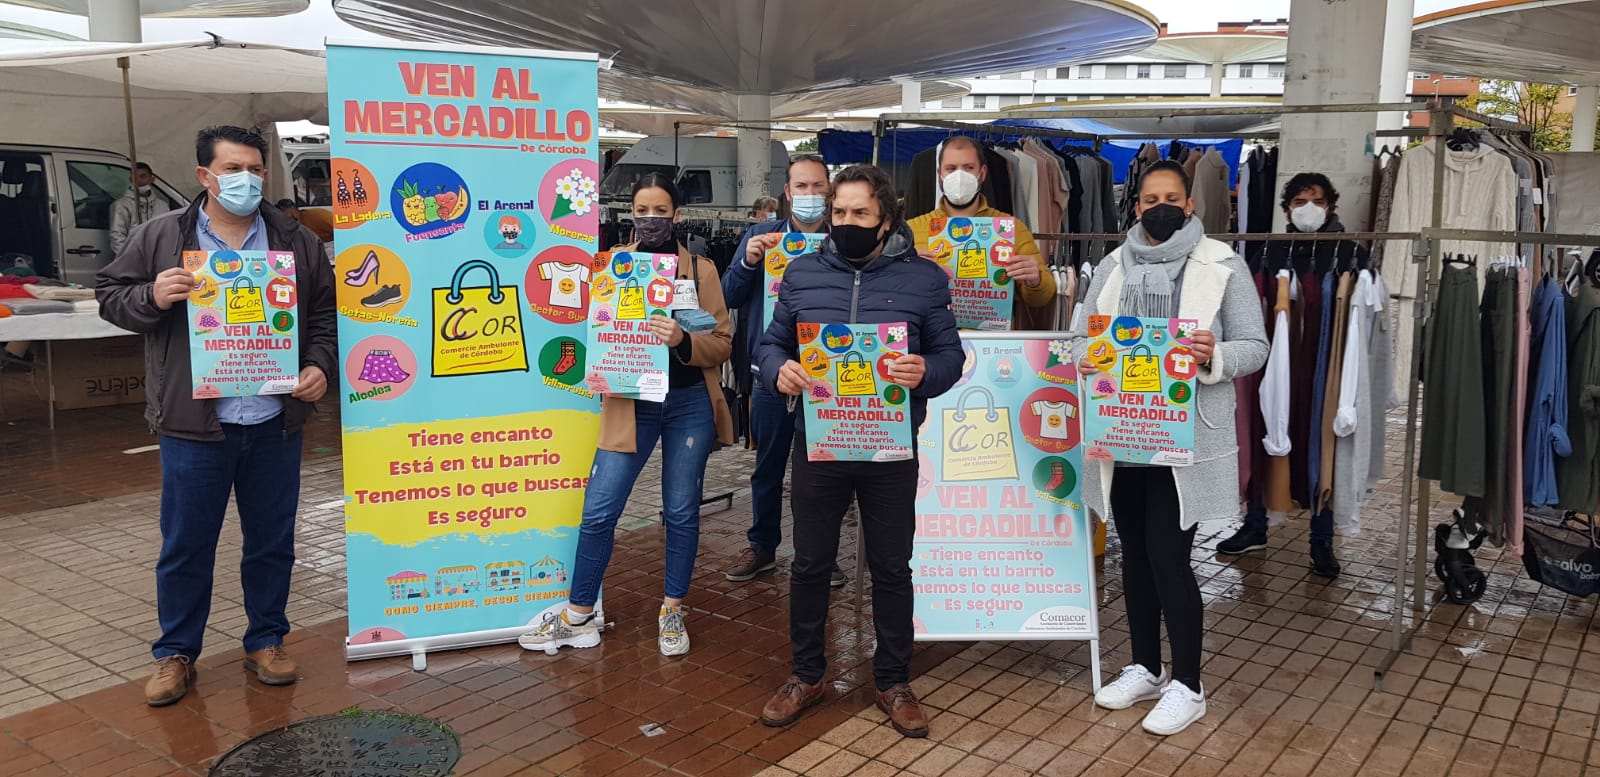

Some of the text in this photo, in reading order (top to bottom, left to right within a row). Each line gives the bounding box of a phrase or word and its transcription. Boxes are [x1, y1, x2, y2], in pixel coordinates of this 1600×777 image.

[398, 61, 541, 101] VEN AL
[344, 100, 592, 142] MERCADILLO
[521, 143, 587, 154] De Córdoba
[478, 200, 535, 211] El Arenal
[334, 213, 349, 224] La
[549, 222, 595, 243] Moreras
[954, 280, 993, 289] VEN AL
[949, 289, 1008, 300] ERCADILLO
[223, 325, 251, 337] VEN
[256, 324, 273, 336] AL
[613, 321, 651, 332] VEN AL
[204, 338, 292, 351] MERCADILLO
[597, 333, 663, 346] MERCADILLO
[440, 340, 519, 355] Comercio Ambulante
[459, 348, 503, 359] de Córdoba
[623, 346, 646, 354] seguro
[982, 346, 1023, 355] El Arenal
[240, 352, 268, 361] seguro
[257, 366, 282, 374] barrio
[592, 365, 621, 373] Tenemos
[348, 383, 392, 404] Alcolea
[1118, 393, 1145, 405] VEN
[1150, 395, 1168, 407] AL
[835, 396, 862, 408] VEN
[868, 397, 885, 408] AL
[817, 408, 905, 423] MERCADILLO
[1098, 405, 1188, 422] MERCADILLO
[832, 427, 854, 435] Tiene
[851, 422, 879, 430] seguro
[1132, 421, 1161, 430] seguro
[407, 426, 553, 448] Tiene encanto
[1135, 429, 1170, 437] encanto
[1094, 440, 1130, 449] Tenemos
[1141, 444, 1157, 452] que
[1159, 446, 1189, 454] buscas
[1149, 437, 1175, 445] barrio
[389, 448, 561, 476] Está en tu barrio
[355, 476, 589, 505] Tenemos lo que buscas
[935, 485, 1035, 509] VEN AL
[428, 505, 527, 528] Es seguro
[929, 547, 1044, 561] Tiene encanto
[919, 562, 1055, 577] Está en tu barrio
[913, 581, 1082, 596] nemos lo que buscas
[944, 598, 1024, 616] Es seguro
[1040, 612, 1086, 622] Comacor
